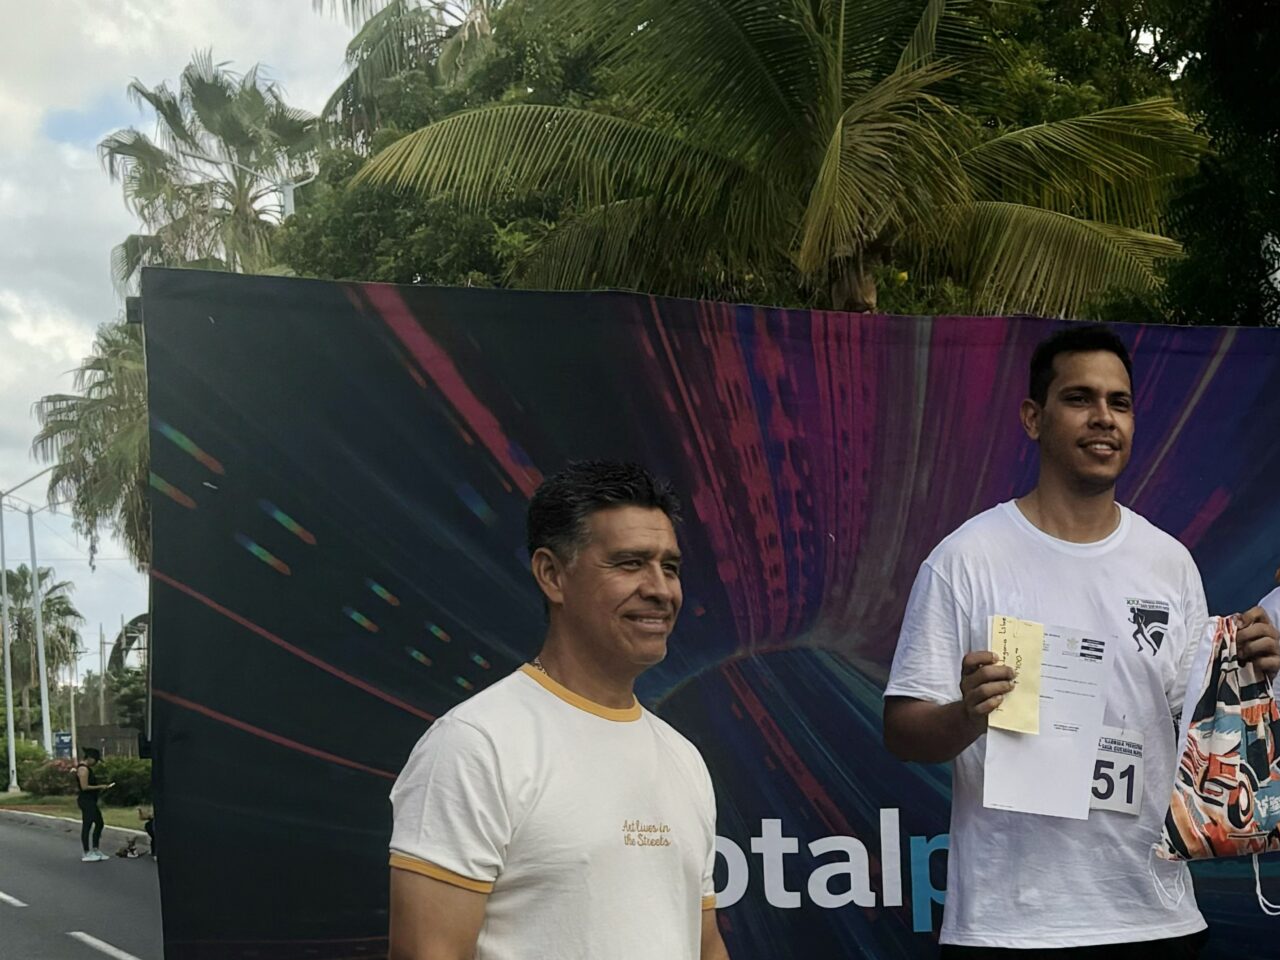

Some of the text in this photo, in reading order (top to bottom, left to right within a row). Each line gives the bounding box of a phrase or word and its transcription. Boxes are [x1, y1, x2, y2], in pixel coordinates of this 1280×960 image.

[1091, 759, 1135, 804] 51
[623, 832, 672, 847] the Streets
[659, 821, 671, 833] in
[714, 808, 950, 932] otalp
